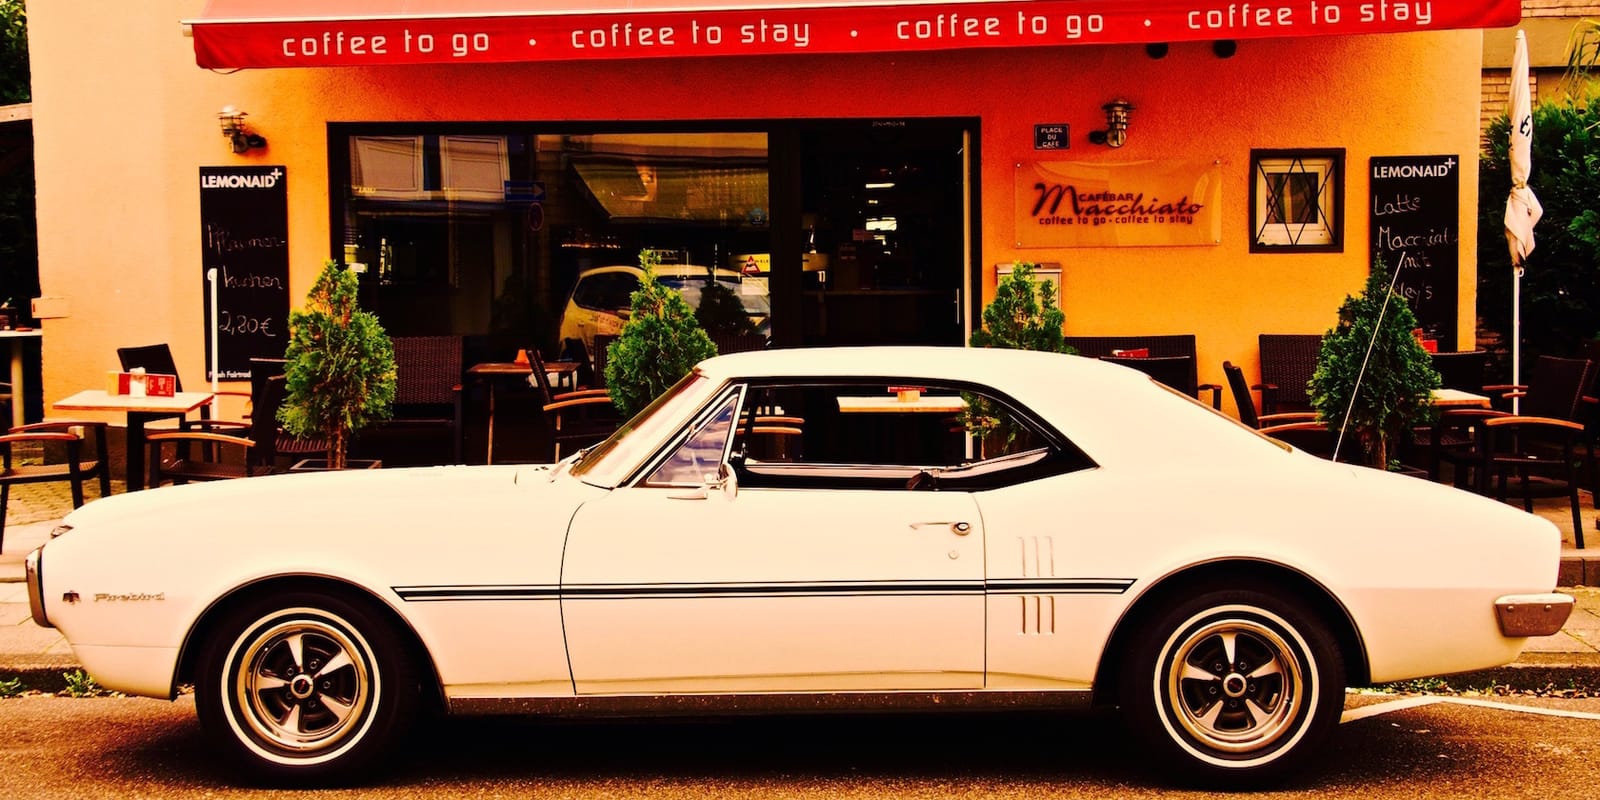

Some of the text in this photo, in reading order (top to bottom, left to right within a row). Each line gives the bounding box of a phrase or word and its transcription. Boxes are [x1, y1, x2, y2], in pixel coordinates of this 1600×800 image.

[282, 0, 1433, 57] coffee to go coffee to stay coffee to go coffee to stay
[1047, 133, 1057, 141] DU
[1031, 182, 1204, 217] Macchiato
[1374, 193, 1421, 216] Latte
[1039, 214, 1193, 226] coffee to go coffee to stay
